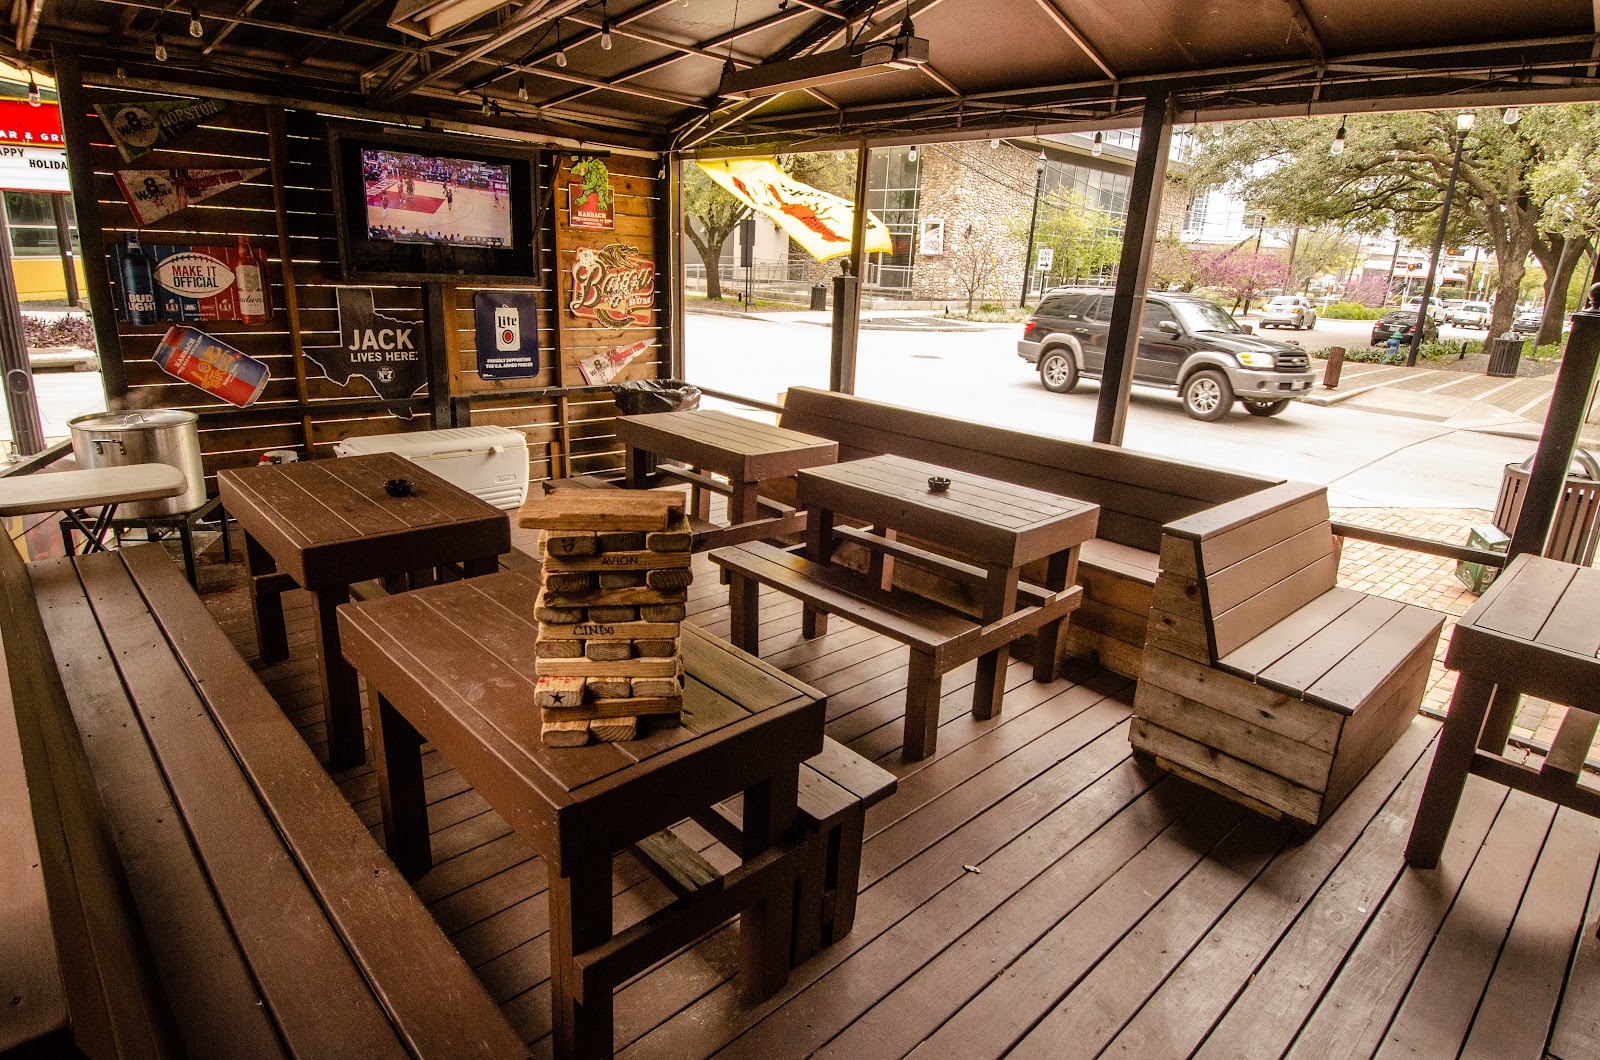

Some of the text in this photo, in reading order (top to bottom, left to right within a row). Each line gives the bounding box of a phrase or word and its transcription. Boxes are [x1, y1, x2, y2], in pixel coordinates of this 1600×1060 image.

[24, 131, 33, 140] &
[134, 188, 172, 201] WONDER
[577, 211, 607, 219] KARBACH
[171, 265, 217, 277] MAKE IT
[173, 276, 219, 288] OFFICIAL
[128, 293, 154, 303] BUD
[628, 296, 651, 306] RUM
[497, 316, 517, 329] Lite
[349, 328, 414, 351] JACK
[173, 337, 195, 368] KARBACH
[350, 352, 383, 363] LIVES
[190, 345, 222, 389] LOVE
[209, 350, 235, 389] STREET
[601, 556, 639, 566] AVION
